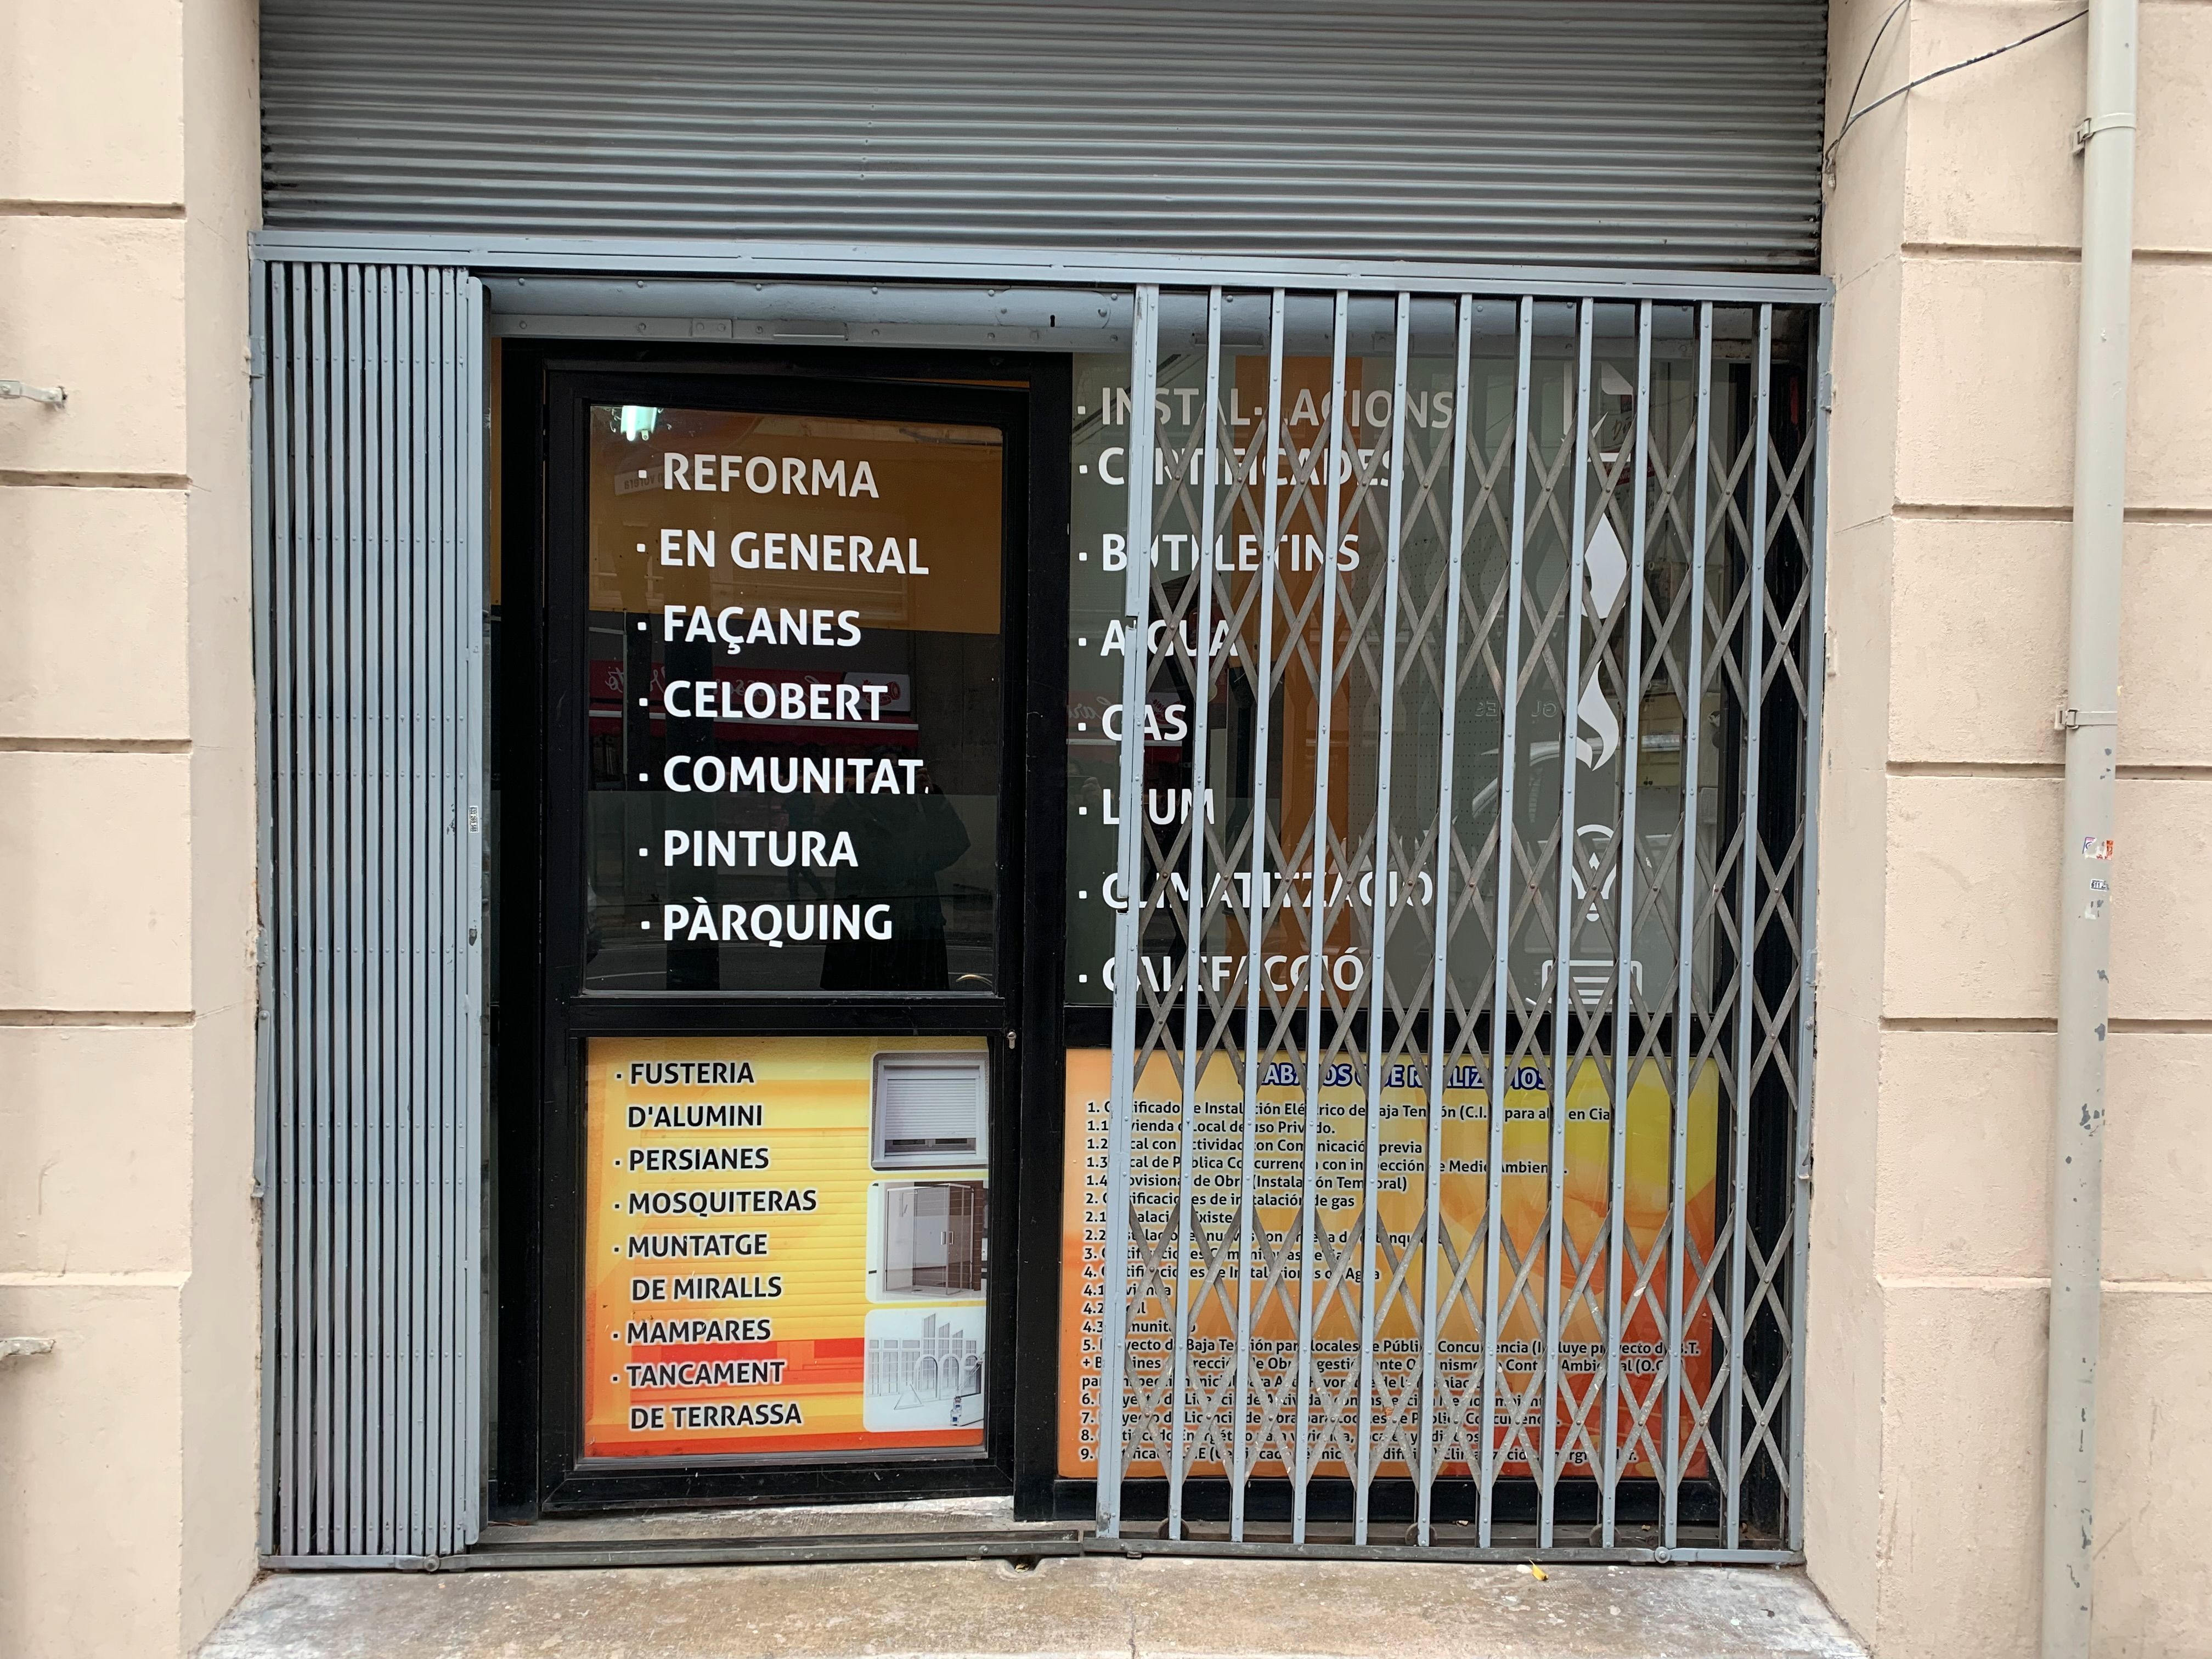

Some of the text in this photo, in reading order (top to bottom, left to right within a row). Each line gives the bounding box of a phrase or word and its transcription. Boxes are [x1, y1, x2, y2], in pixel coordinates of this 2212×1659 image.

[665, 453, 879, 498] REFORMA
[661, 529, 928, 574] EN GENERAL
[665, 605, 860, 654] FAÇANES
[664, 681, 888, 720] CELOBERT
[664, 755, 923, 794] COMUNITAT
[665, 830, 858, 866] PINTURA
[664, 897, 891, 947] PÀRQUING
[631, 1063, 754, 1084] FUSTERIA
[629, 1105, 761, 1127] D'ALUMINI
[1349, 1104, 1365, 1116] de
[1505, 1109, 1534, 1121] para
[1568, 1109, 1585, 1120] en
[1278, 1121, 1335, 1133] Privdo.
[630, 1148, 768, 1170] PERSIANES
[1152, 1141, 1176, 1150] con
[1379, 1141, 1422, 1156] previa
[1152, 1157, 1169, 1168] de
[1173, 1157, 1223, 1169] Pblica
[1323, 1160, 1346, 1170] con
[1194, 1175, 1210, 1187] de
[1336, 1177, 1407, 1192] Temoral)
[630, 1190, 816, 1217] MOSQUITERAS
[1210, 1194, 1227, 1205] de
[1331, 1198, 1355, 1210] gas
[629, 1234, 766, 1257] MUNTATGE
[633, 1277, 781, 1300] DE MIRALLS
[628, 1320, 770, 1343] MAMPARES
[627, 1362, 785, 1386] TANCAMENT
[632, 1404, 801, 1429] DE TERRASSA
